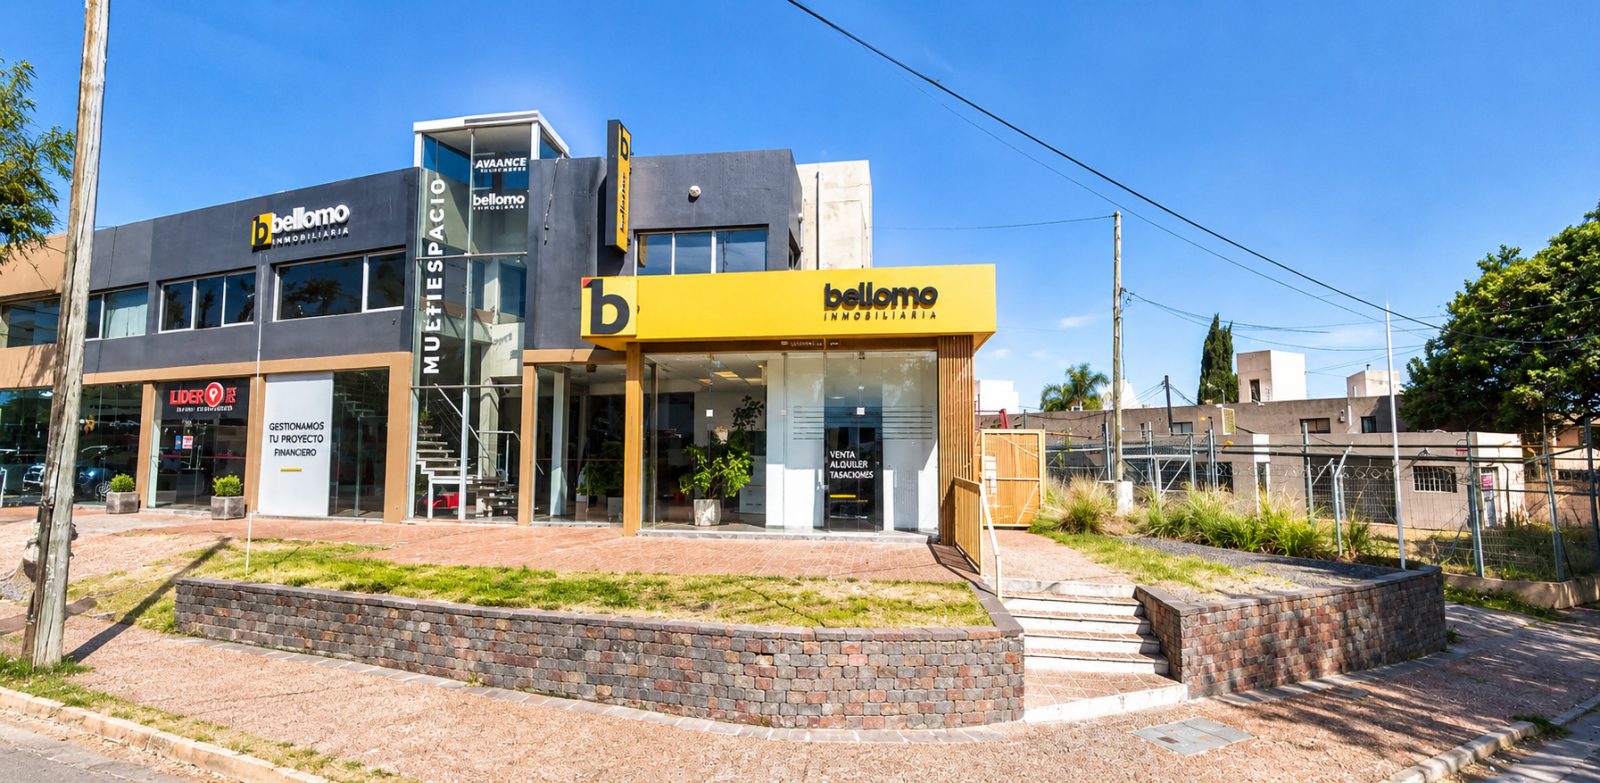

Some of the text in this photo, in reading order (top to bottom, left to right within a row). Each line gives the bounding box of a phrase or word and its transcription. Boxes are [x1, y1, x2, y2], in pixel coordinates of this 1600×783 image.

[474, 157, 528, 169] AVAANCE
[472, 192, 526, 206] bellomo
[272, 204, 350, 234] bellomo
[272, 227, 350, 245] INMOBILIARIA
[824, 281, 938, 310] bellomo
[585, 278, 630, 335] b
[823, 310, 937, 322] INMOBILIARIA
[269, 421, 325, 431] GESTIONAMOS
[269, 434, 324, 443] TU PROYECTO
[829, 450, 856, 459] VENTA
[829, 460, 869, 469] ALQUILER
[829, 470, 874, 479] TASACIONES
